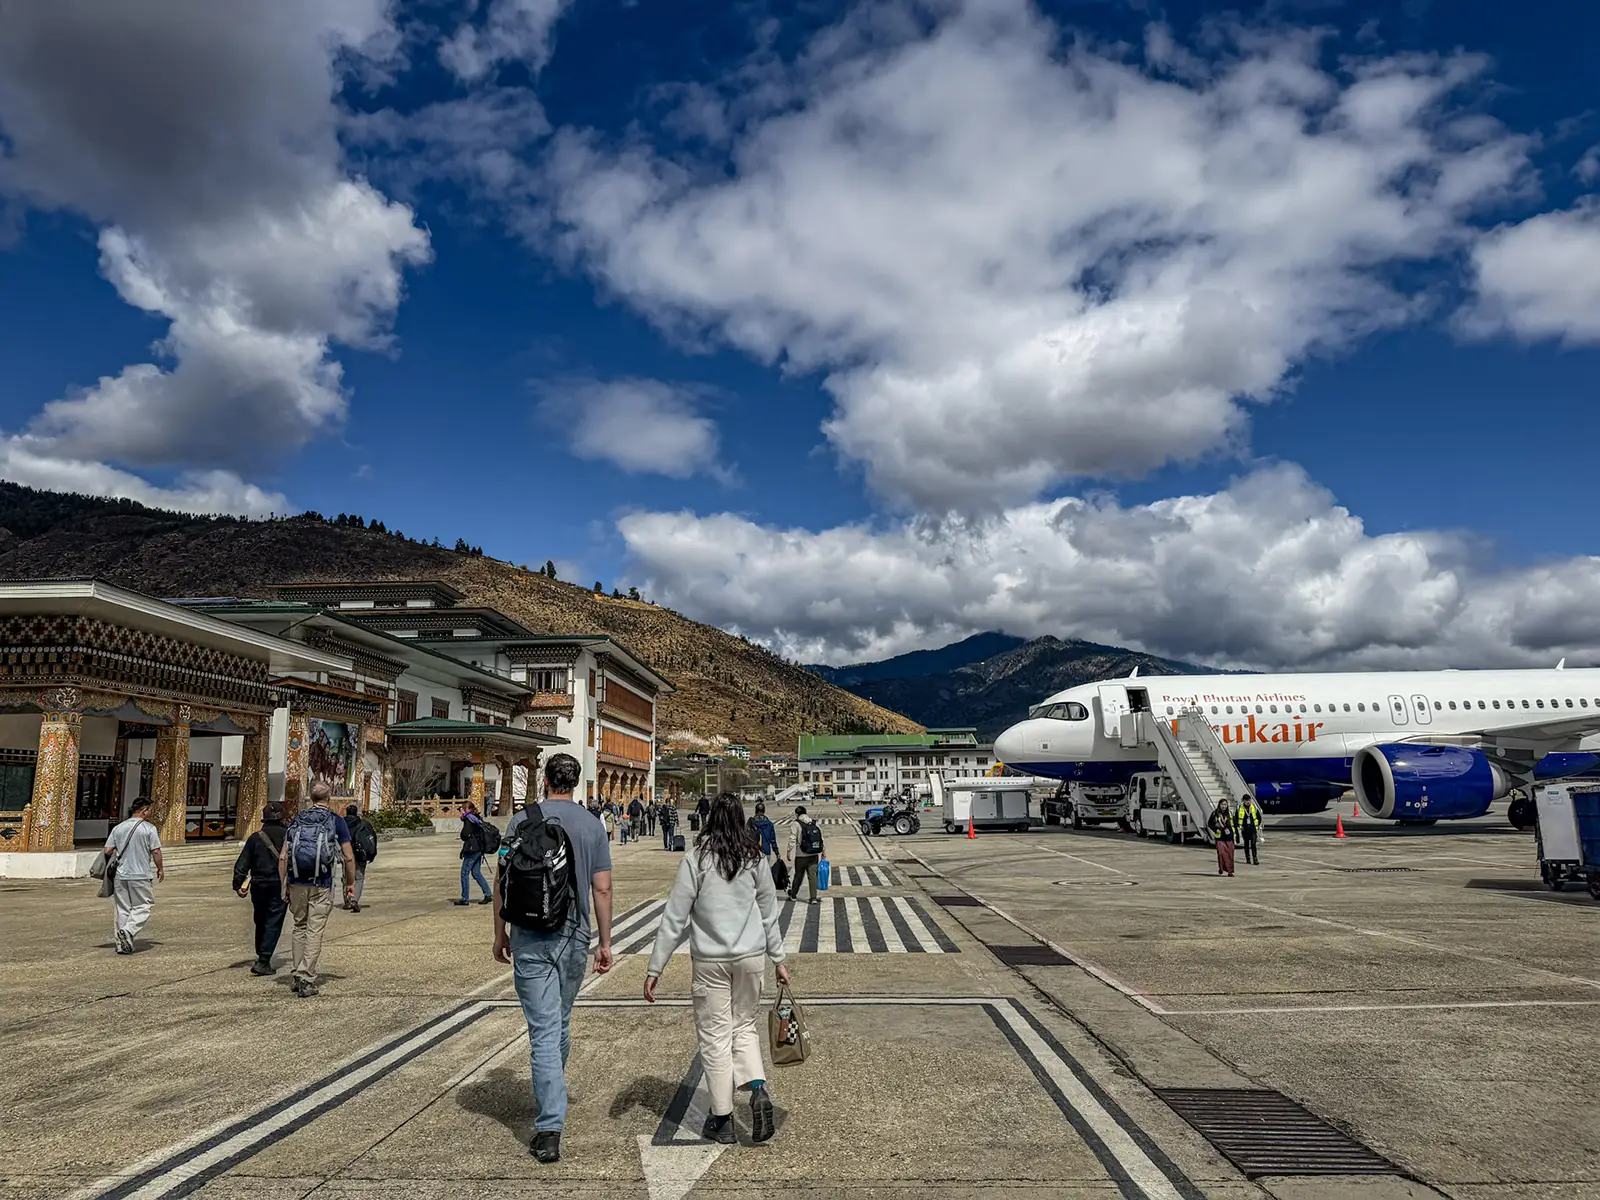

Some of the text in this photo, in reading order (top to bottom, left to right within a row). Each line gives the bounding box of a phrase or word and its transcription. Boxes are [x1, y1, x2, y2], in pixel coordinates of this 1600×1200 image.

[1162, 693, 1307, 703] Royal Bhutan Airlines
[1170, 714, 1324, 744] ukair
